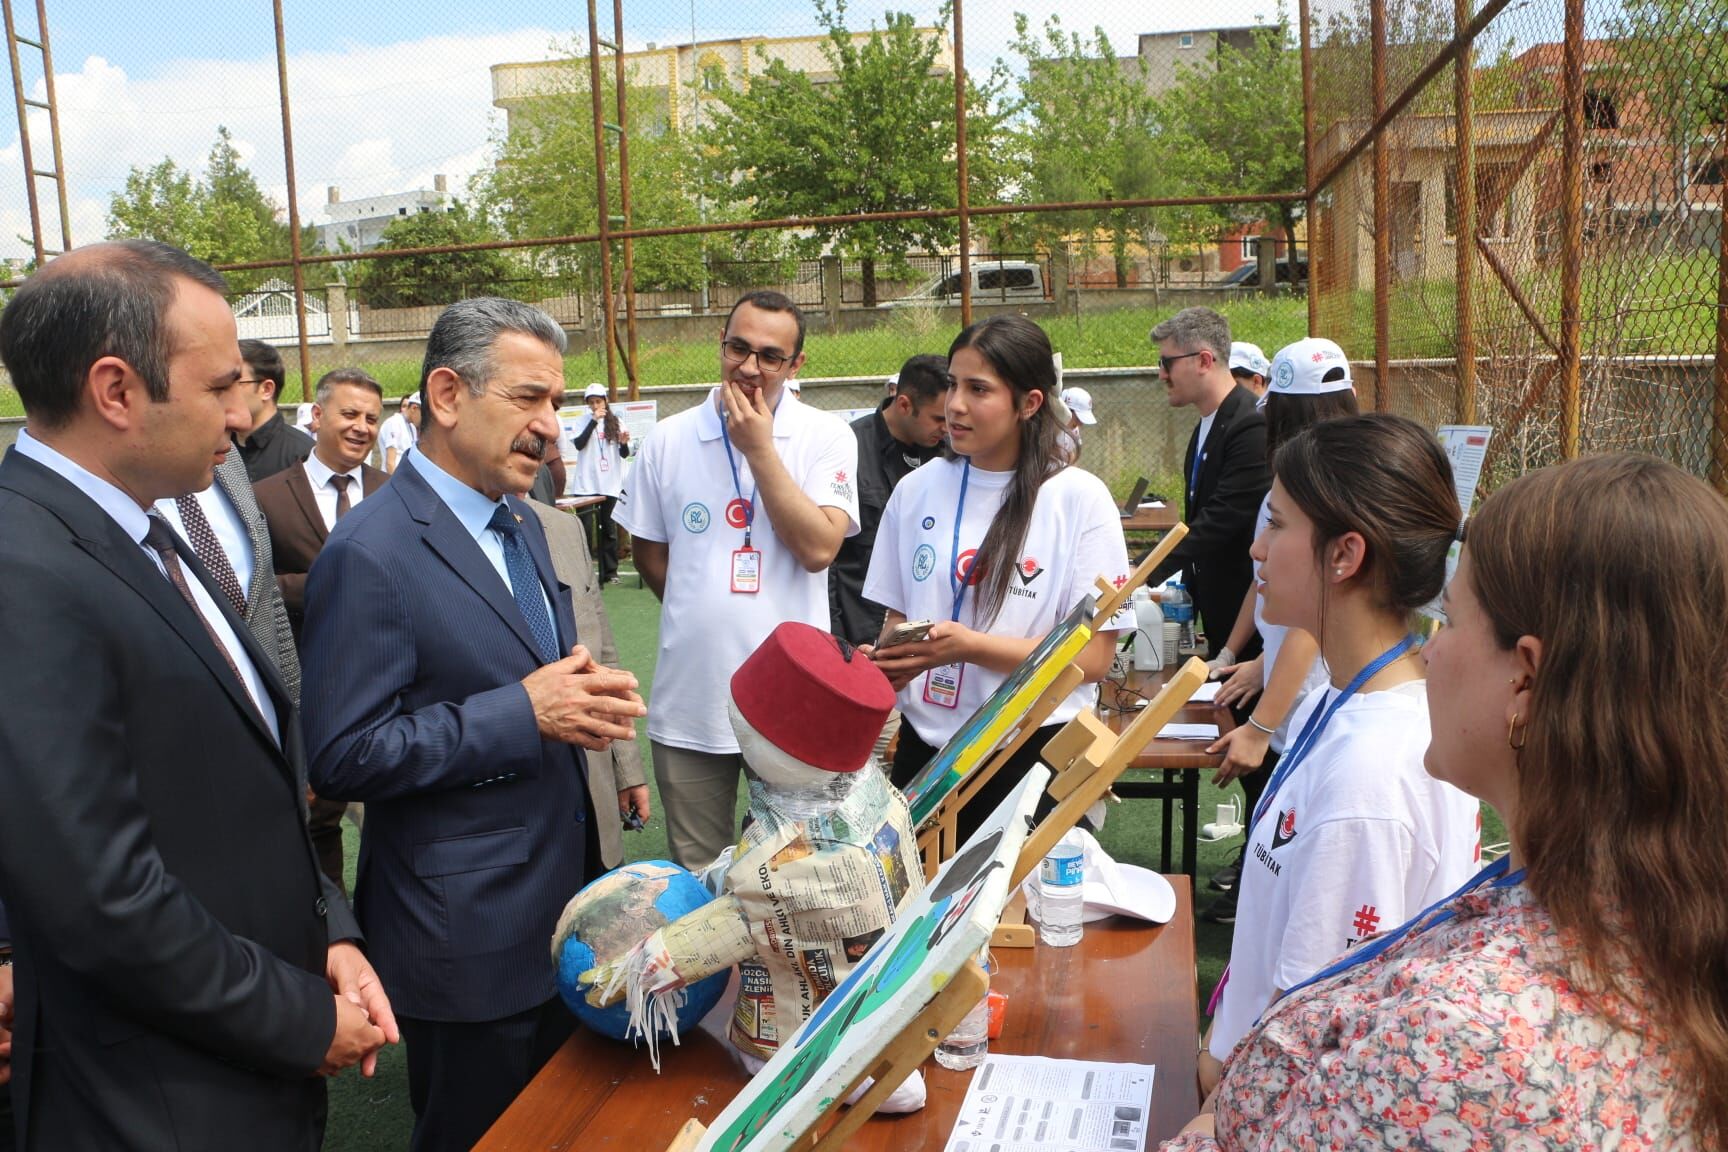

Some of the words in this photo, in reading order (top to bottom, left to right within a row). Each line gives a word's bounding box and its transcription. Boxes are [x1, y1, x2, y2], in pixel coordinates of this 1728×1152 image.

[1008, 585, 1038, 600] TÜBİTAK
[1253, 842, 1282, 877] TÜBİTAK
[766, 892, 780, 906] VE
